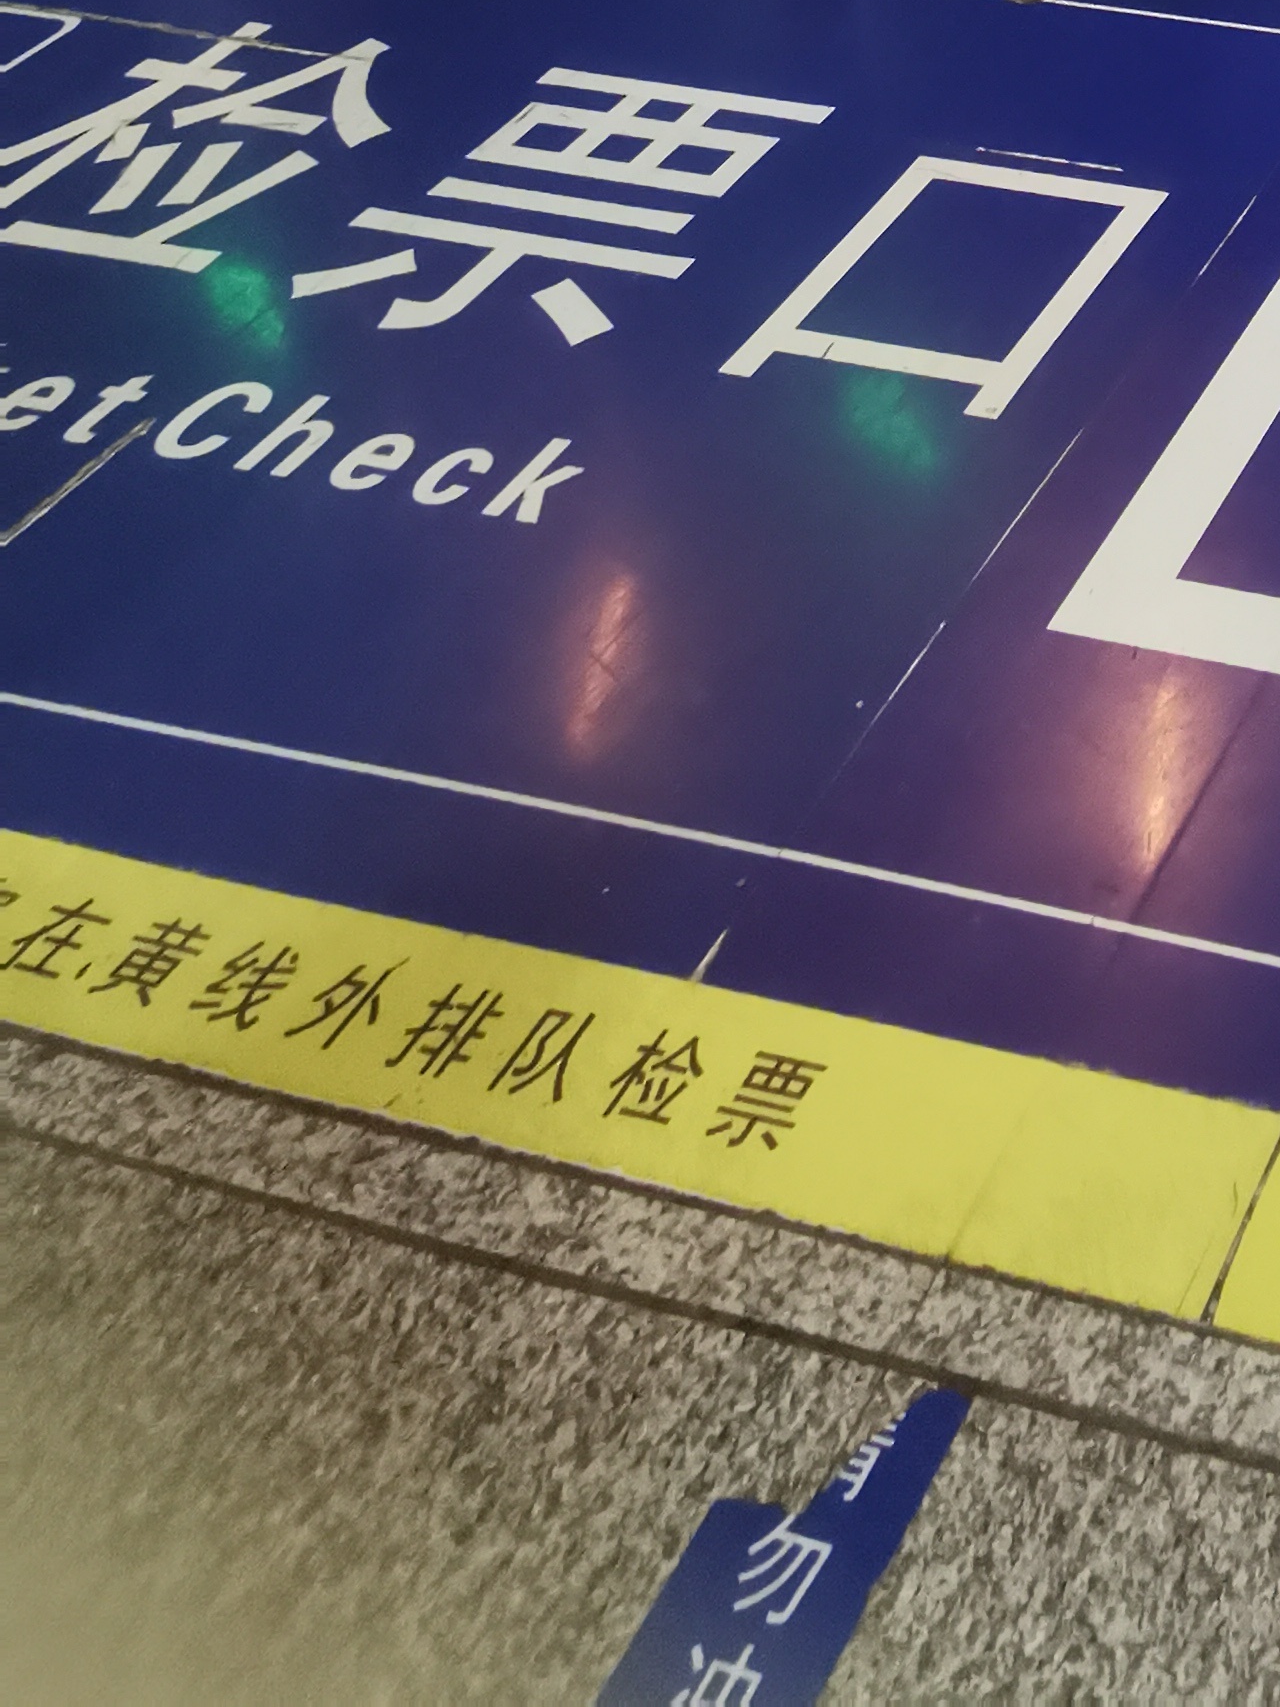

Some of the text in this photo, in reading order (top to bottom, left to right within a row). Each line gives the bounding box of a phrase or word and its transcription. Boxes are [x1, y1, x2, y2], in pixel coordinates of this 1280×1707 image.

[0, 21, 1169, 419] 检票口
[0, 343, 585, 524] et Check
